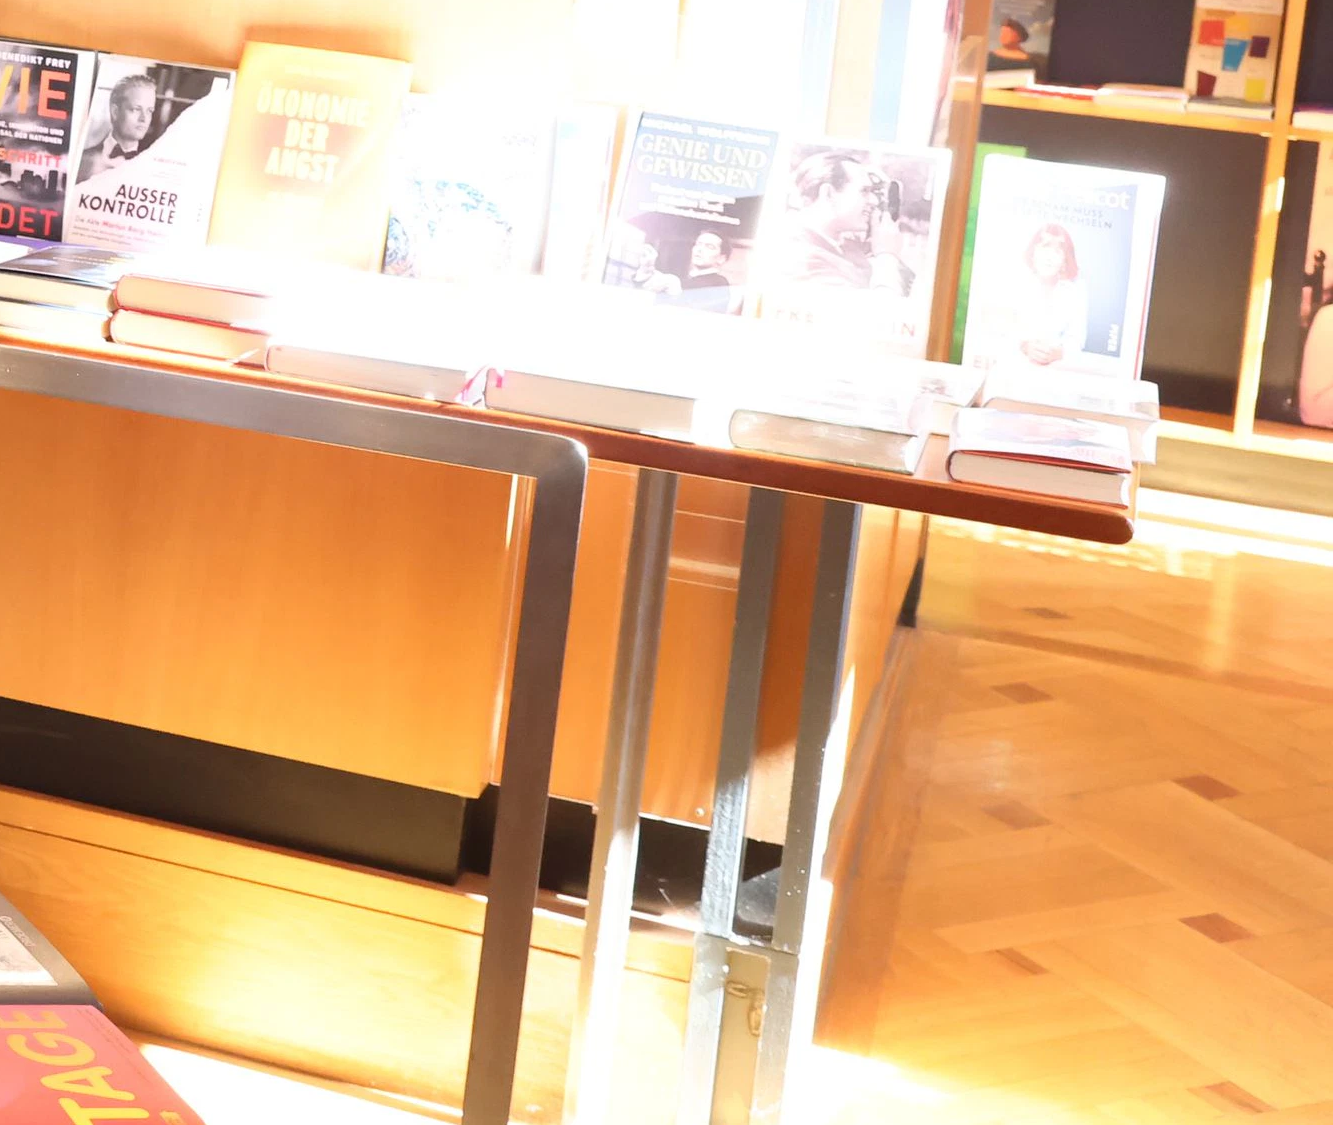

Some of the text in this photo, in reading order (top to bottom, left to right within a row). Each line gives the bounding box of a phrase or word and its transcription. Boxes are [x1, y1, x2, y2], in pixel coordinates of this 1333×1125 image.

[46, 56, 71, 69] FREY
[30, 132, 63, 145] NATIONEN
[284, 118, 330, 152] DER
[635, 133, 710, 161] GENIE
[713, 143, 768, 168] UND
[264, 146, 342, 184] ANGST
[635, 154, 758, 190] GEWISSEN
[79, 194, 174, 225] KONTROLLE
[115, 184, 178, 207] AUSSER
